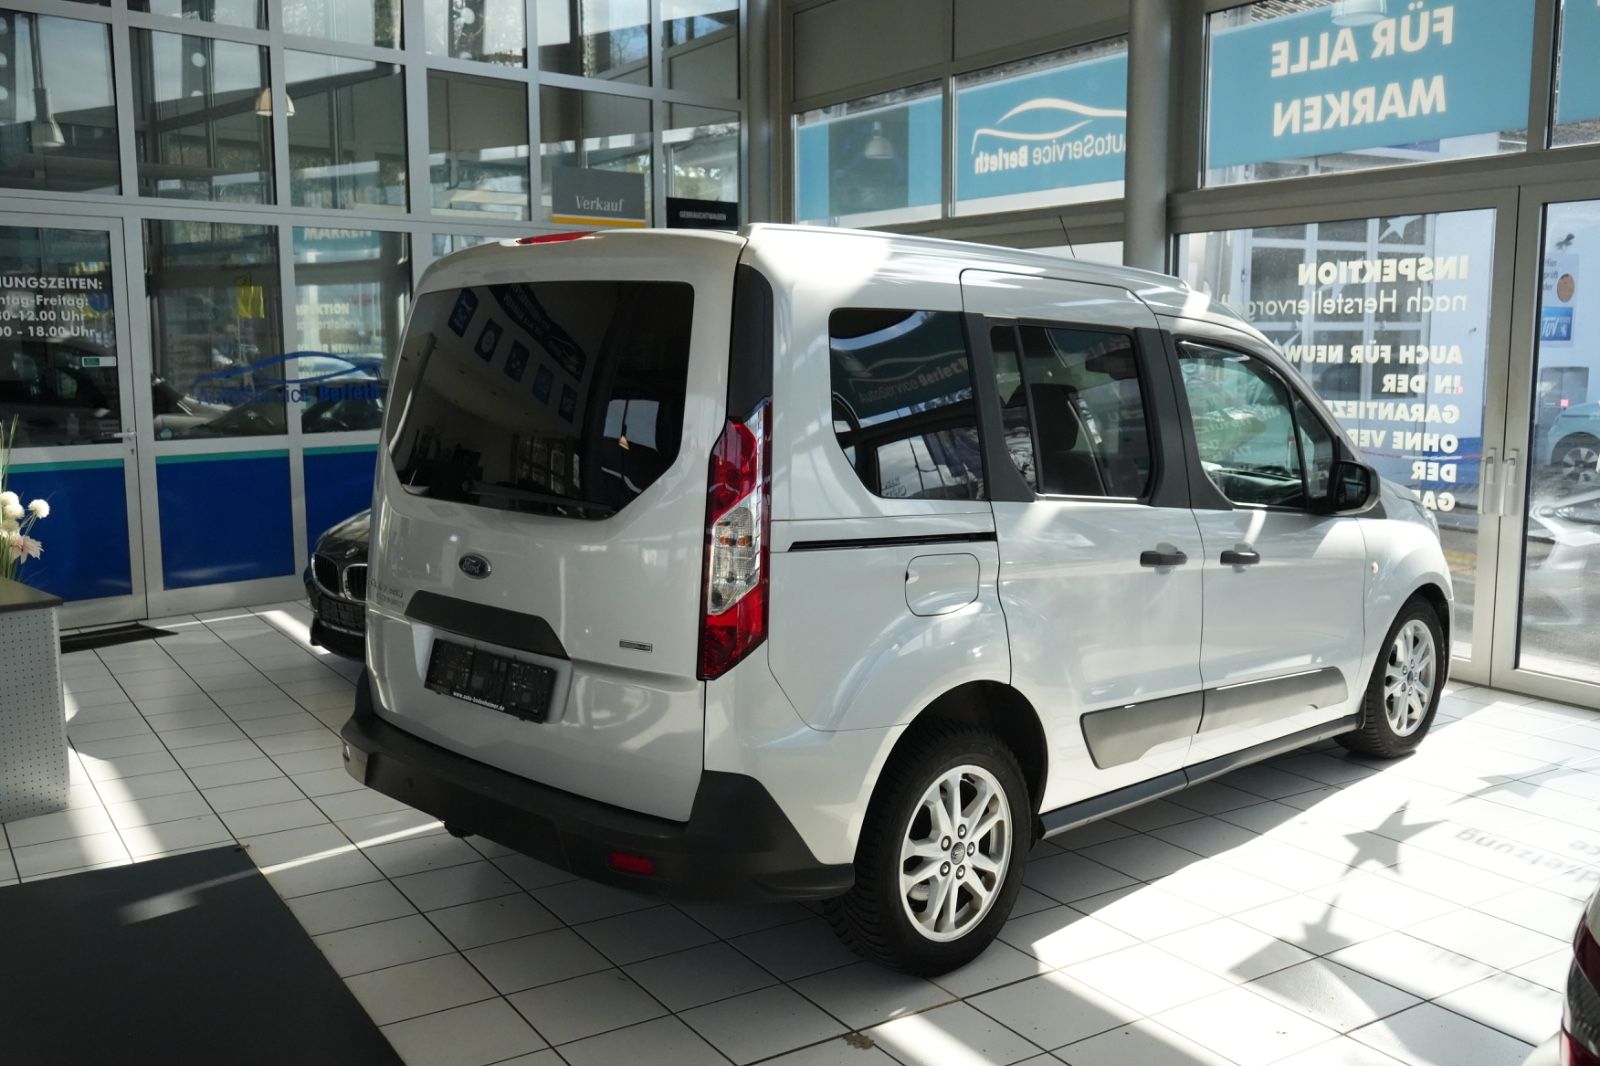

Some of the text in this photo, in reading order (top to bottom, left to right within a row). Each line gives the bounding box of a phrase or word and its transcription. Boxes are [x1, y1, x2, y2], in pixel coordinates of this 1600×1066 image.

[576, 195, 624, 212] Verkauf
[0, 276, 102, 289] UNGSZEITEN:
[61, 311, 85, 321] Uhr
[70, 326, 95, 337] Uhr
